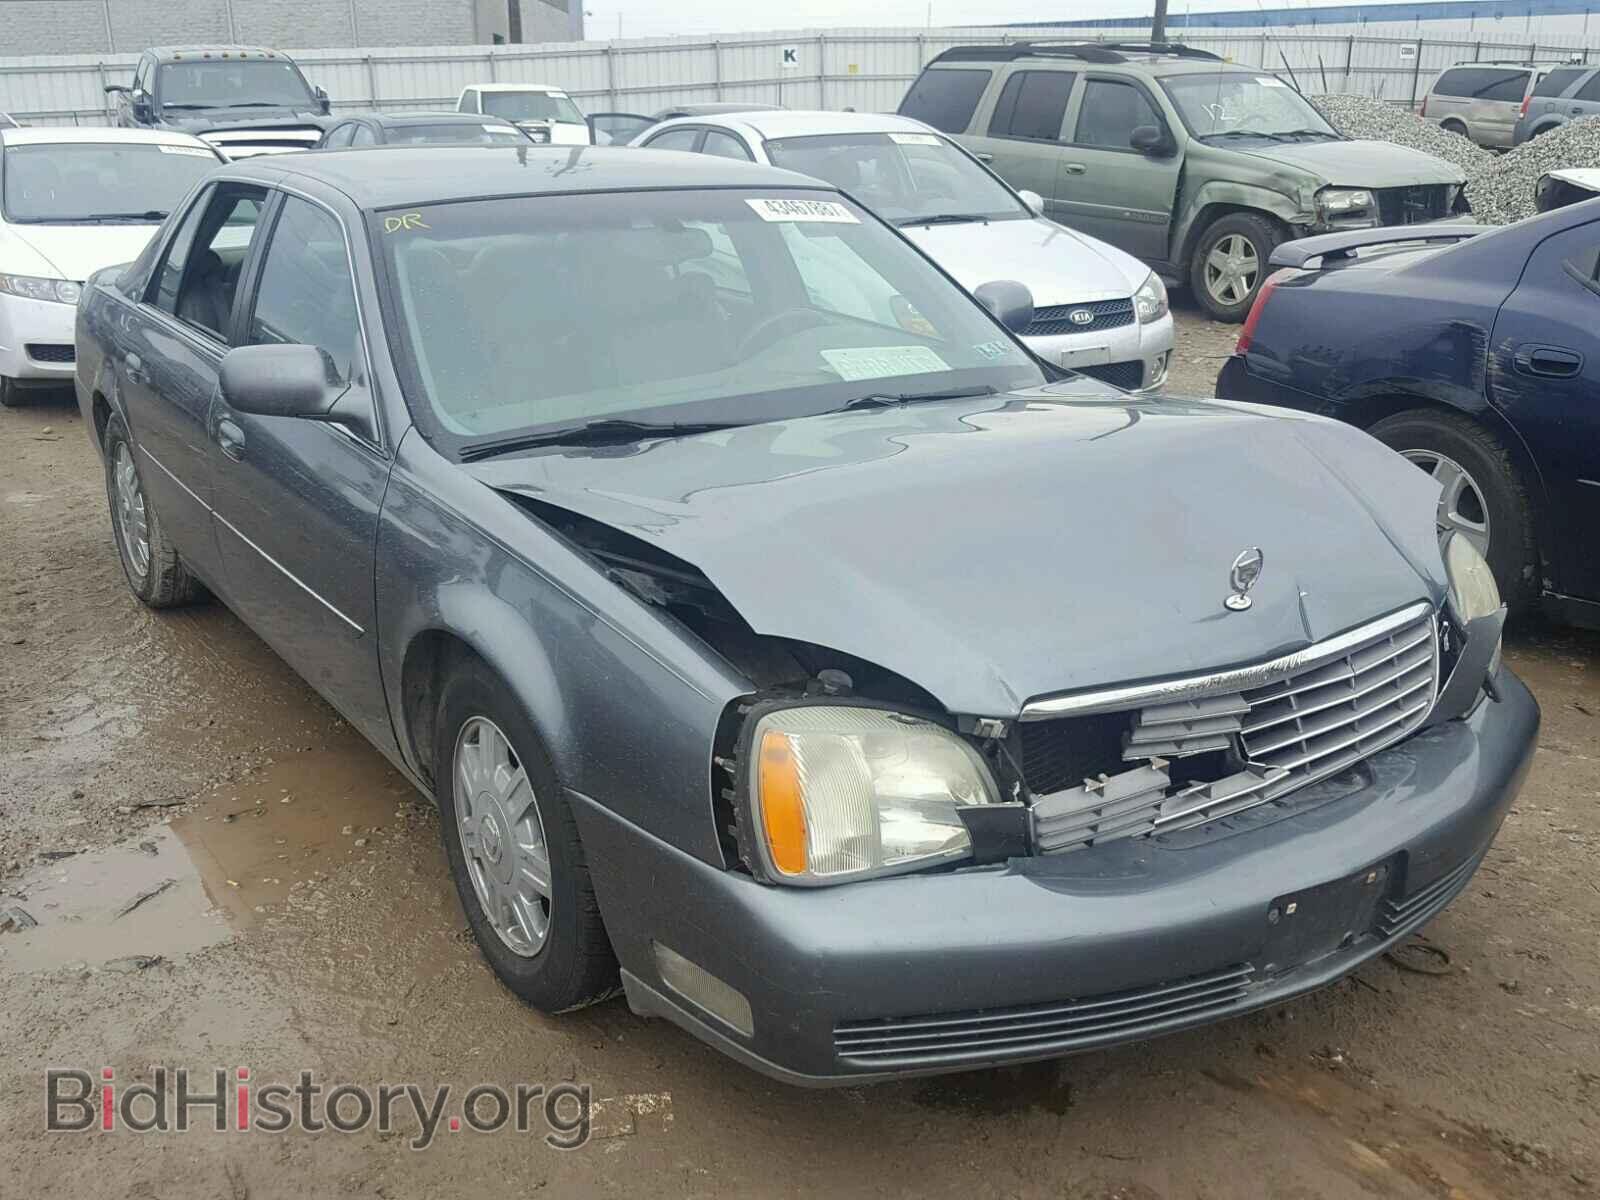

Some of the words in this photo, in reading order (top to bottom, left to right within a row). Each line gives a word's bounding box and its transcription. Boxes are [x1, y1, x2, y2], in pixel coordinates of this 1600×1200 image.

[784, 49, 796, 62] K
[385, 212, 432, 233] DR
[1074, 313, 1092, 321] KIA
